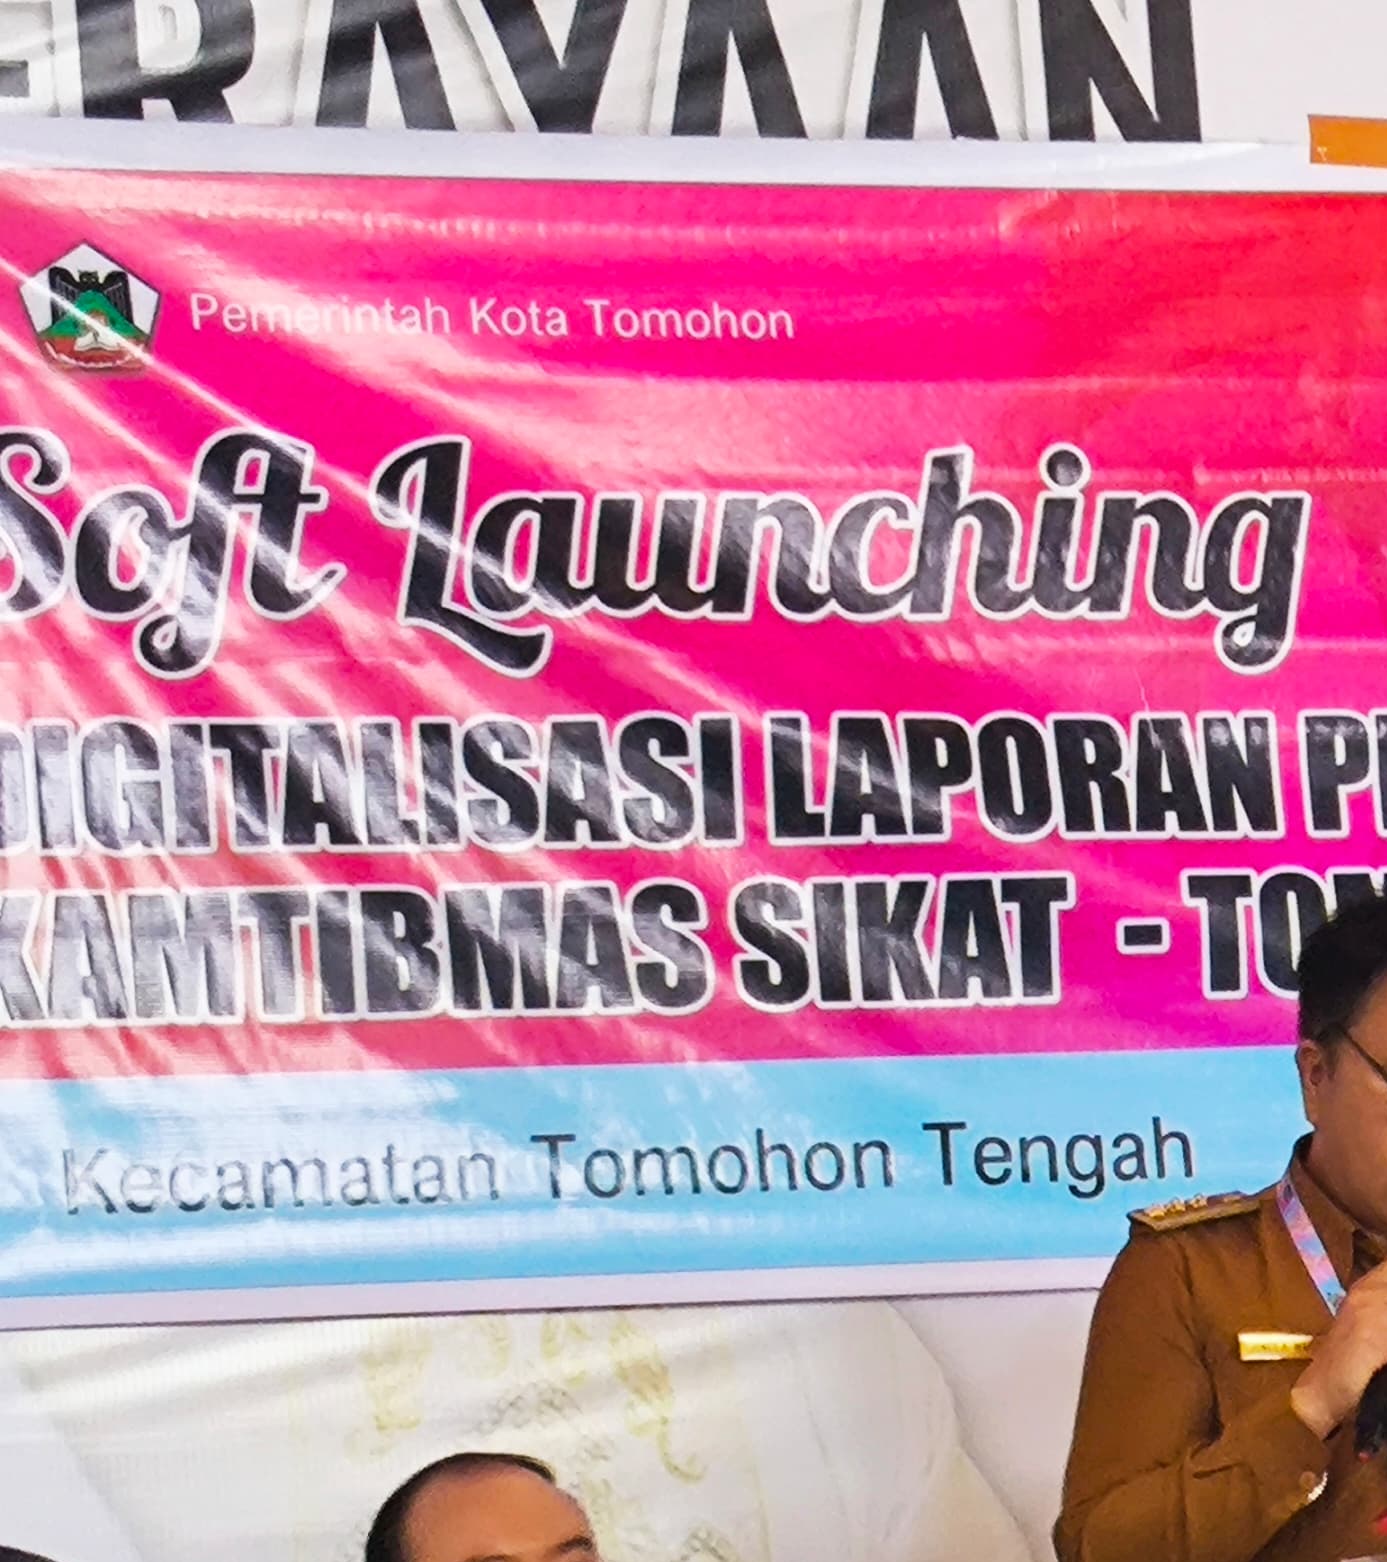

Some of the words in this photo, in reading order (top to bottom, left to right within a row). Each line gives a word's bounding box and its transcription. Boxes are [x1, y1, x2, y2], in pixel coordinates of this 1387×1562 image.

[191, 293, 449, 336] Pemerintah
[470, 296, 567, 339] Kota
[591, 297, 794, 340] Tomohon
[0, 426, 346, 681] Soft
[371, 434, 1310, 676] Launching
[763, 706, 1284, 847] LAPORAN
[734, 870, 1074, 1014] SIKAT
[63, 1143, 498, 1215] Kecamatan
[530, 1132, 894, 1198] Tomohon
[922, 1116, 1195, 1204] Tengah
